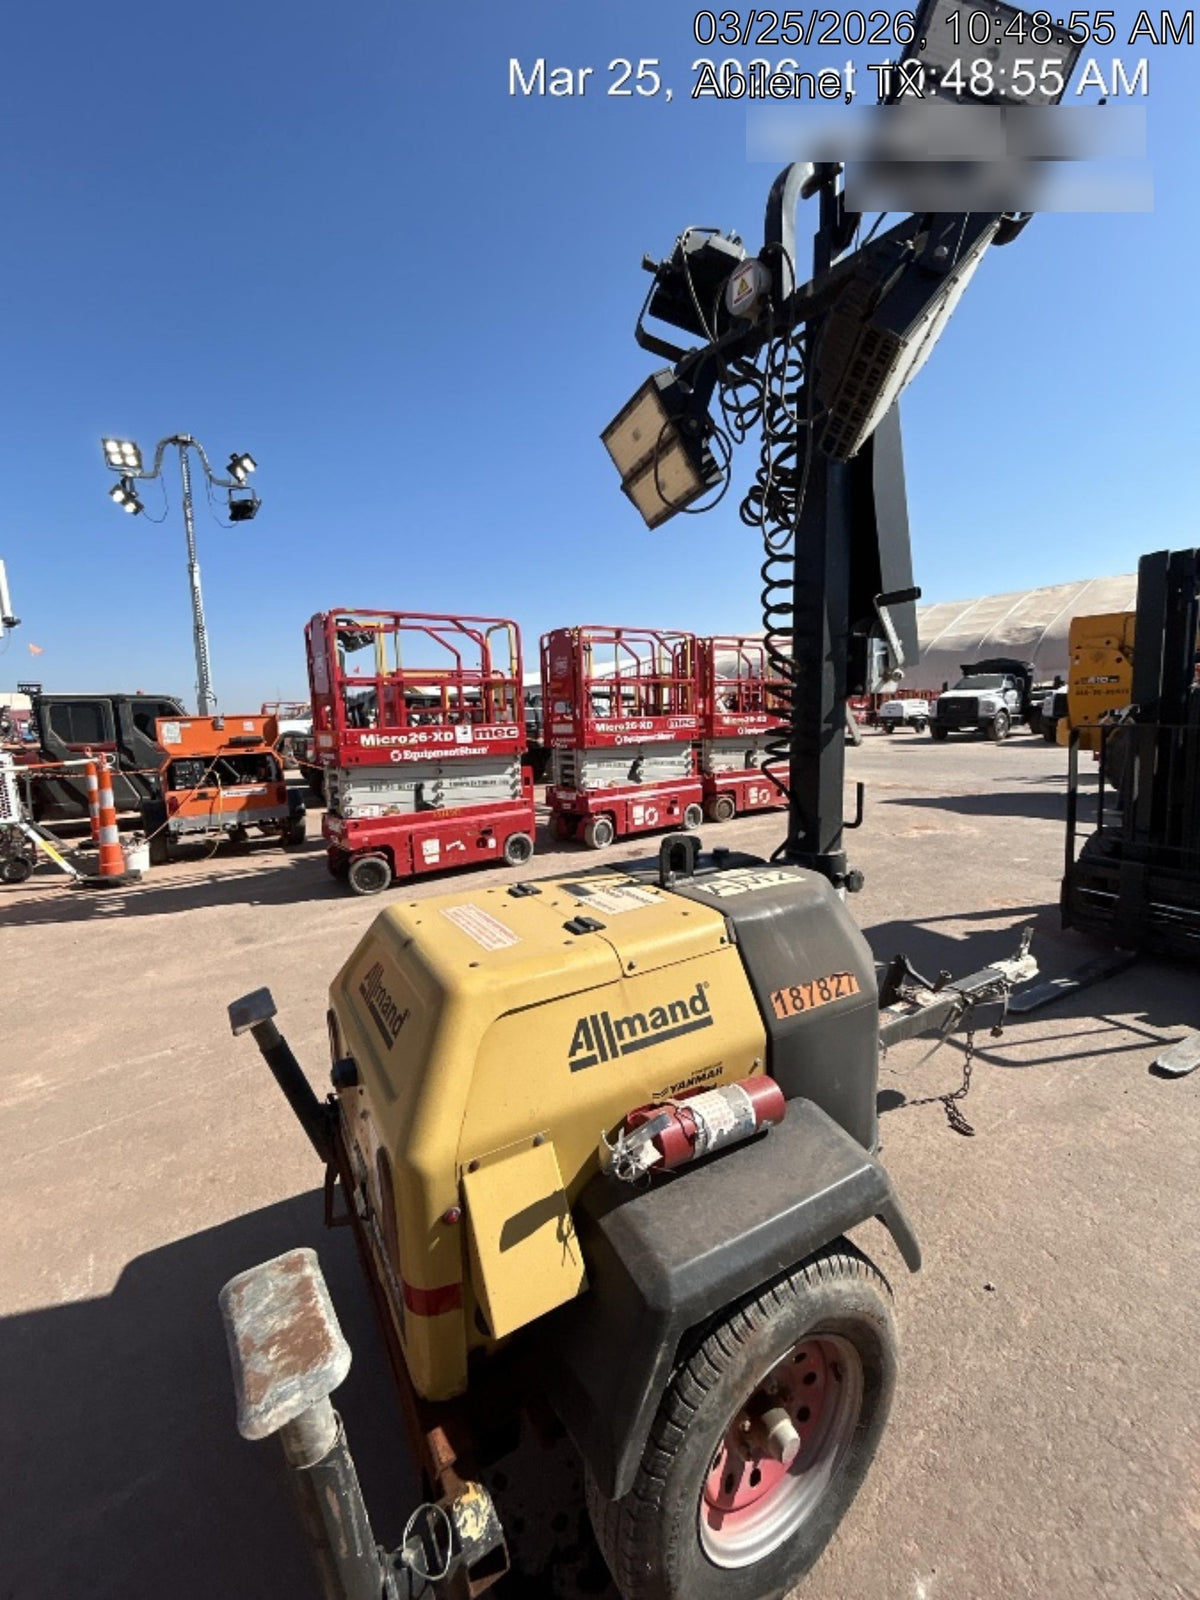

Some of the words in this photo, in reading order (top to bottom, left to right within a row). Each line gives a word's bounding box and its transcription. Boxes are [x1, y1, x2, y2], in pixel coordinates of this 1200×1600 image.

[363, 961, 411, 1040] Allmand
[567, 982, 711, 1064] Allmand
[773, 972, 855, 1015] 187827
[669, 1066, 723, 1094] YANMAR
